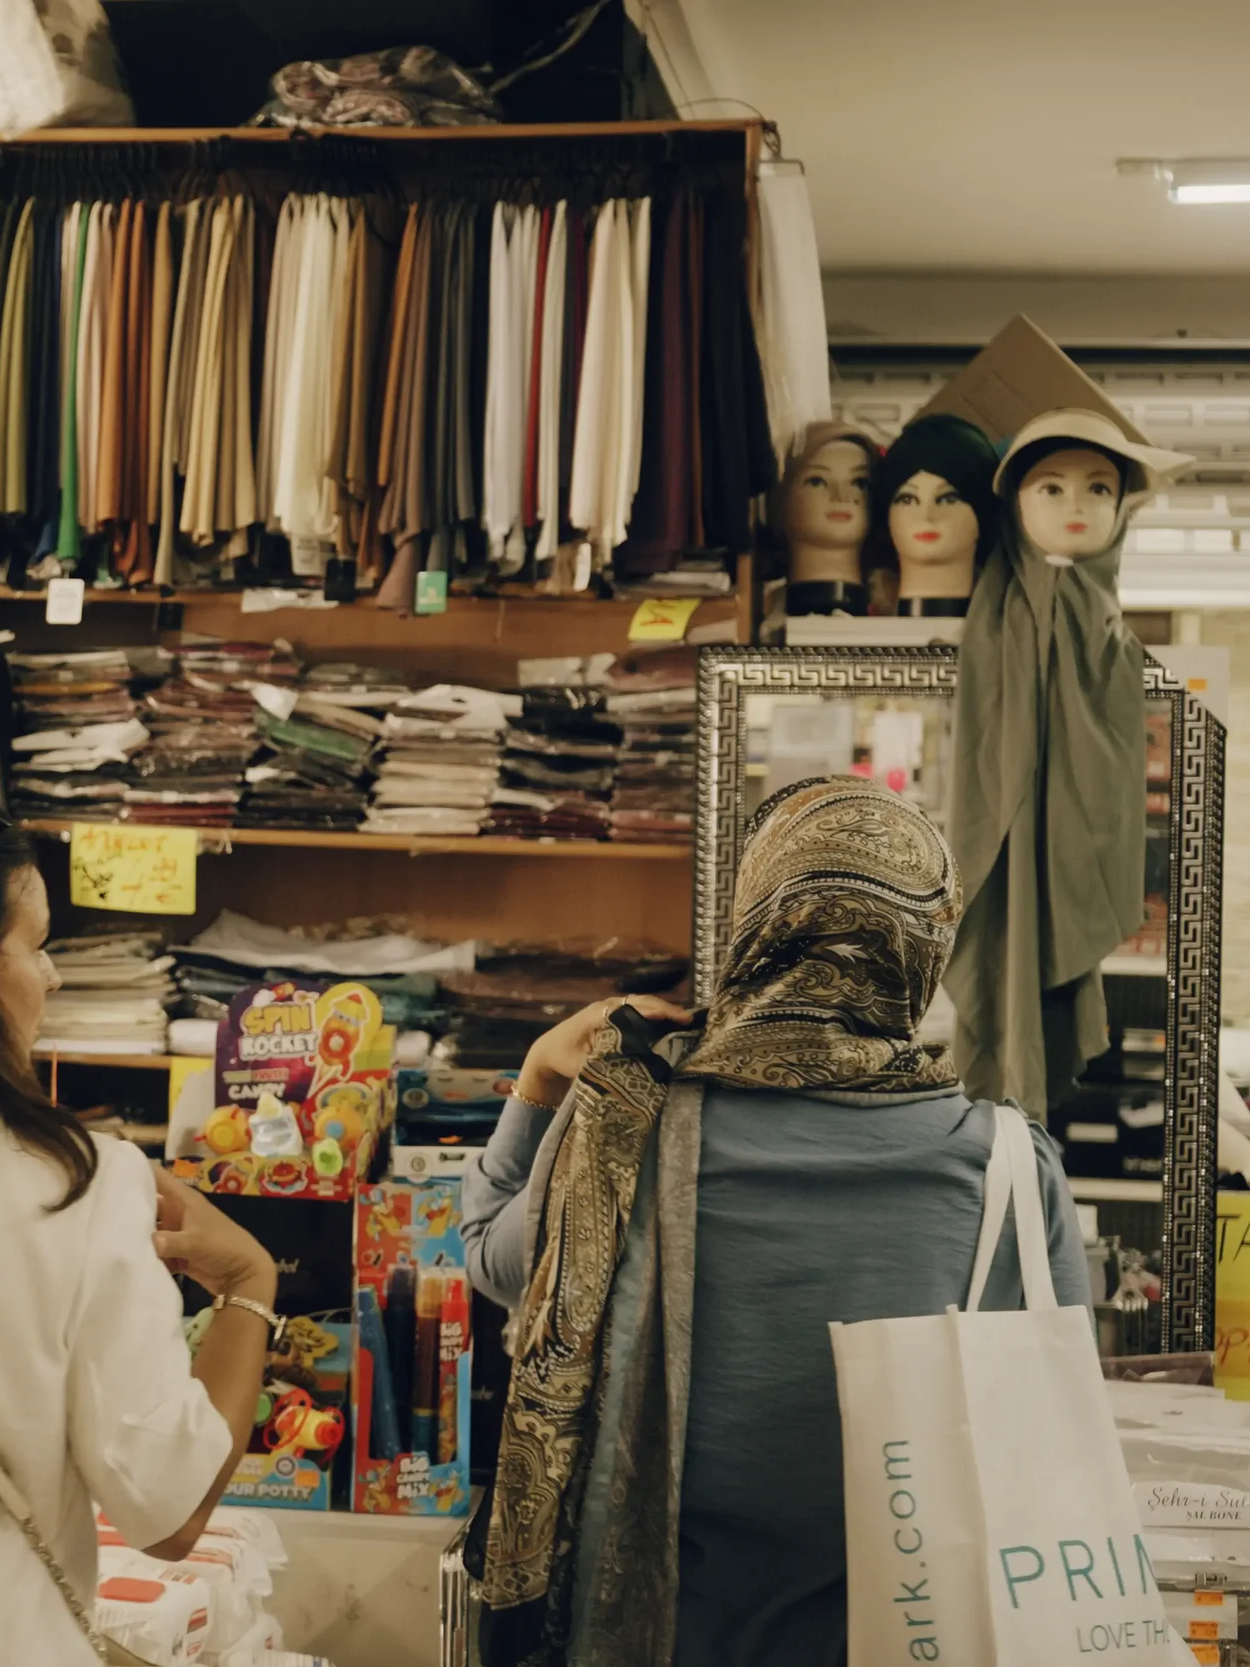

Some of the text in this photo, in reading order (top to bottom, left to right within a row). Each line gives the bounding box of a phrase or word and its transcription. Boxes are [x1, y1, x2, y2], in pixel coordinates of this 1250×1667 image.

[243, 1003, 312, 1035] SPIN
[240, 1033, 318, 1058] ROCKET
[258, 1483, 312, 1499] POTTY
[1209, 1510, 1242, 1520] BONE
[882, 1440, 940, 1662] ark.com
[1076, 1621, 1137, 1653] LOVE
[1141, 1619, 1171, 1646] TH
